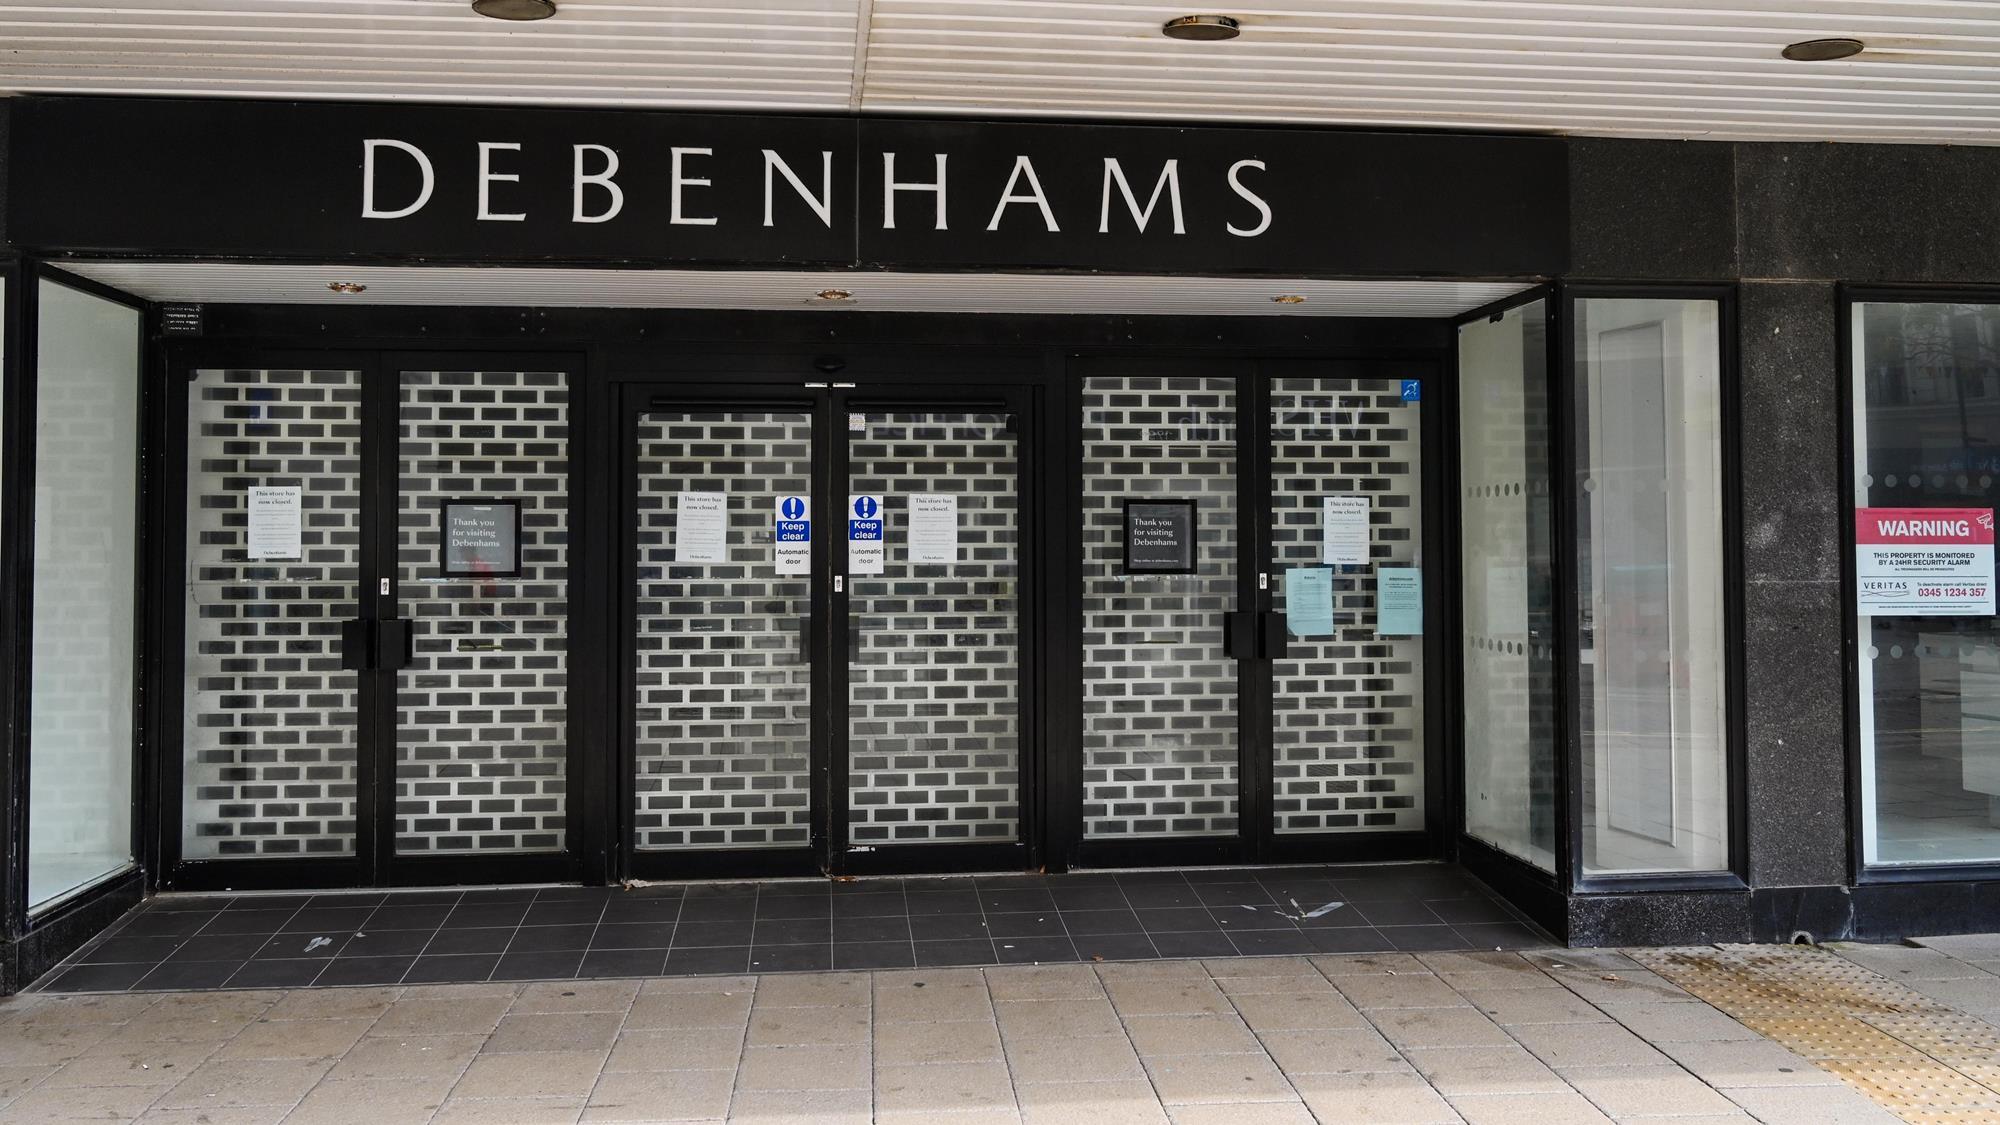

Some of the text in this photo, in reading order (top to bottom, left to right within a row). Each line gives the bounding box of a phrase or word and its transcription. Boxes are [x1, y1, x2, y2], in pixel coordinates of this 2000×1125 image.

[361, 138, 1273, 238] DEBENHAMS
[454, 518, 478, 526] Thank
[782, 522, 804, 531] Keep
[854, 521, 877, 530] Keep
[1134, 518, 1157, 526] Thank
[1878, 520, 1970, 536] WARNING
[466, 528, 496, 538] visiting
[854, 531, 876, 539] clear
[1146, 528, 1174, 538] visiting
[452, 539, 500, 547] Debenhams
[1918, 588, 1986, 596] 0345 1234 357
